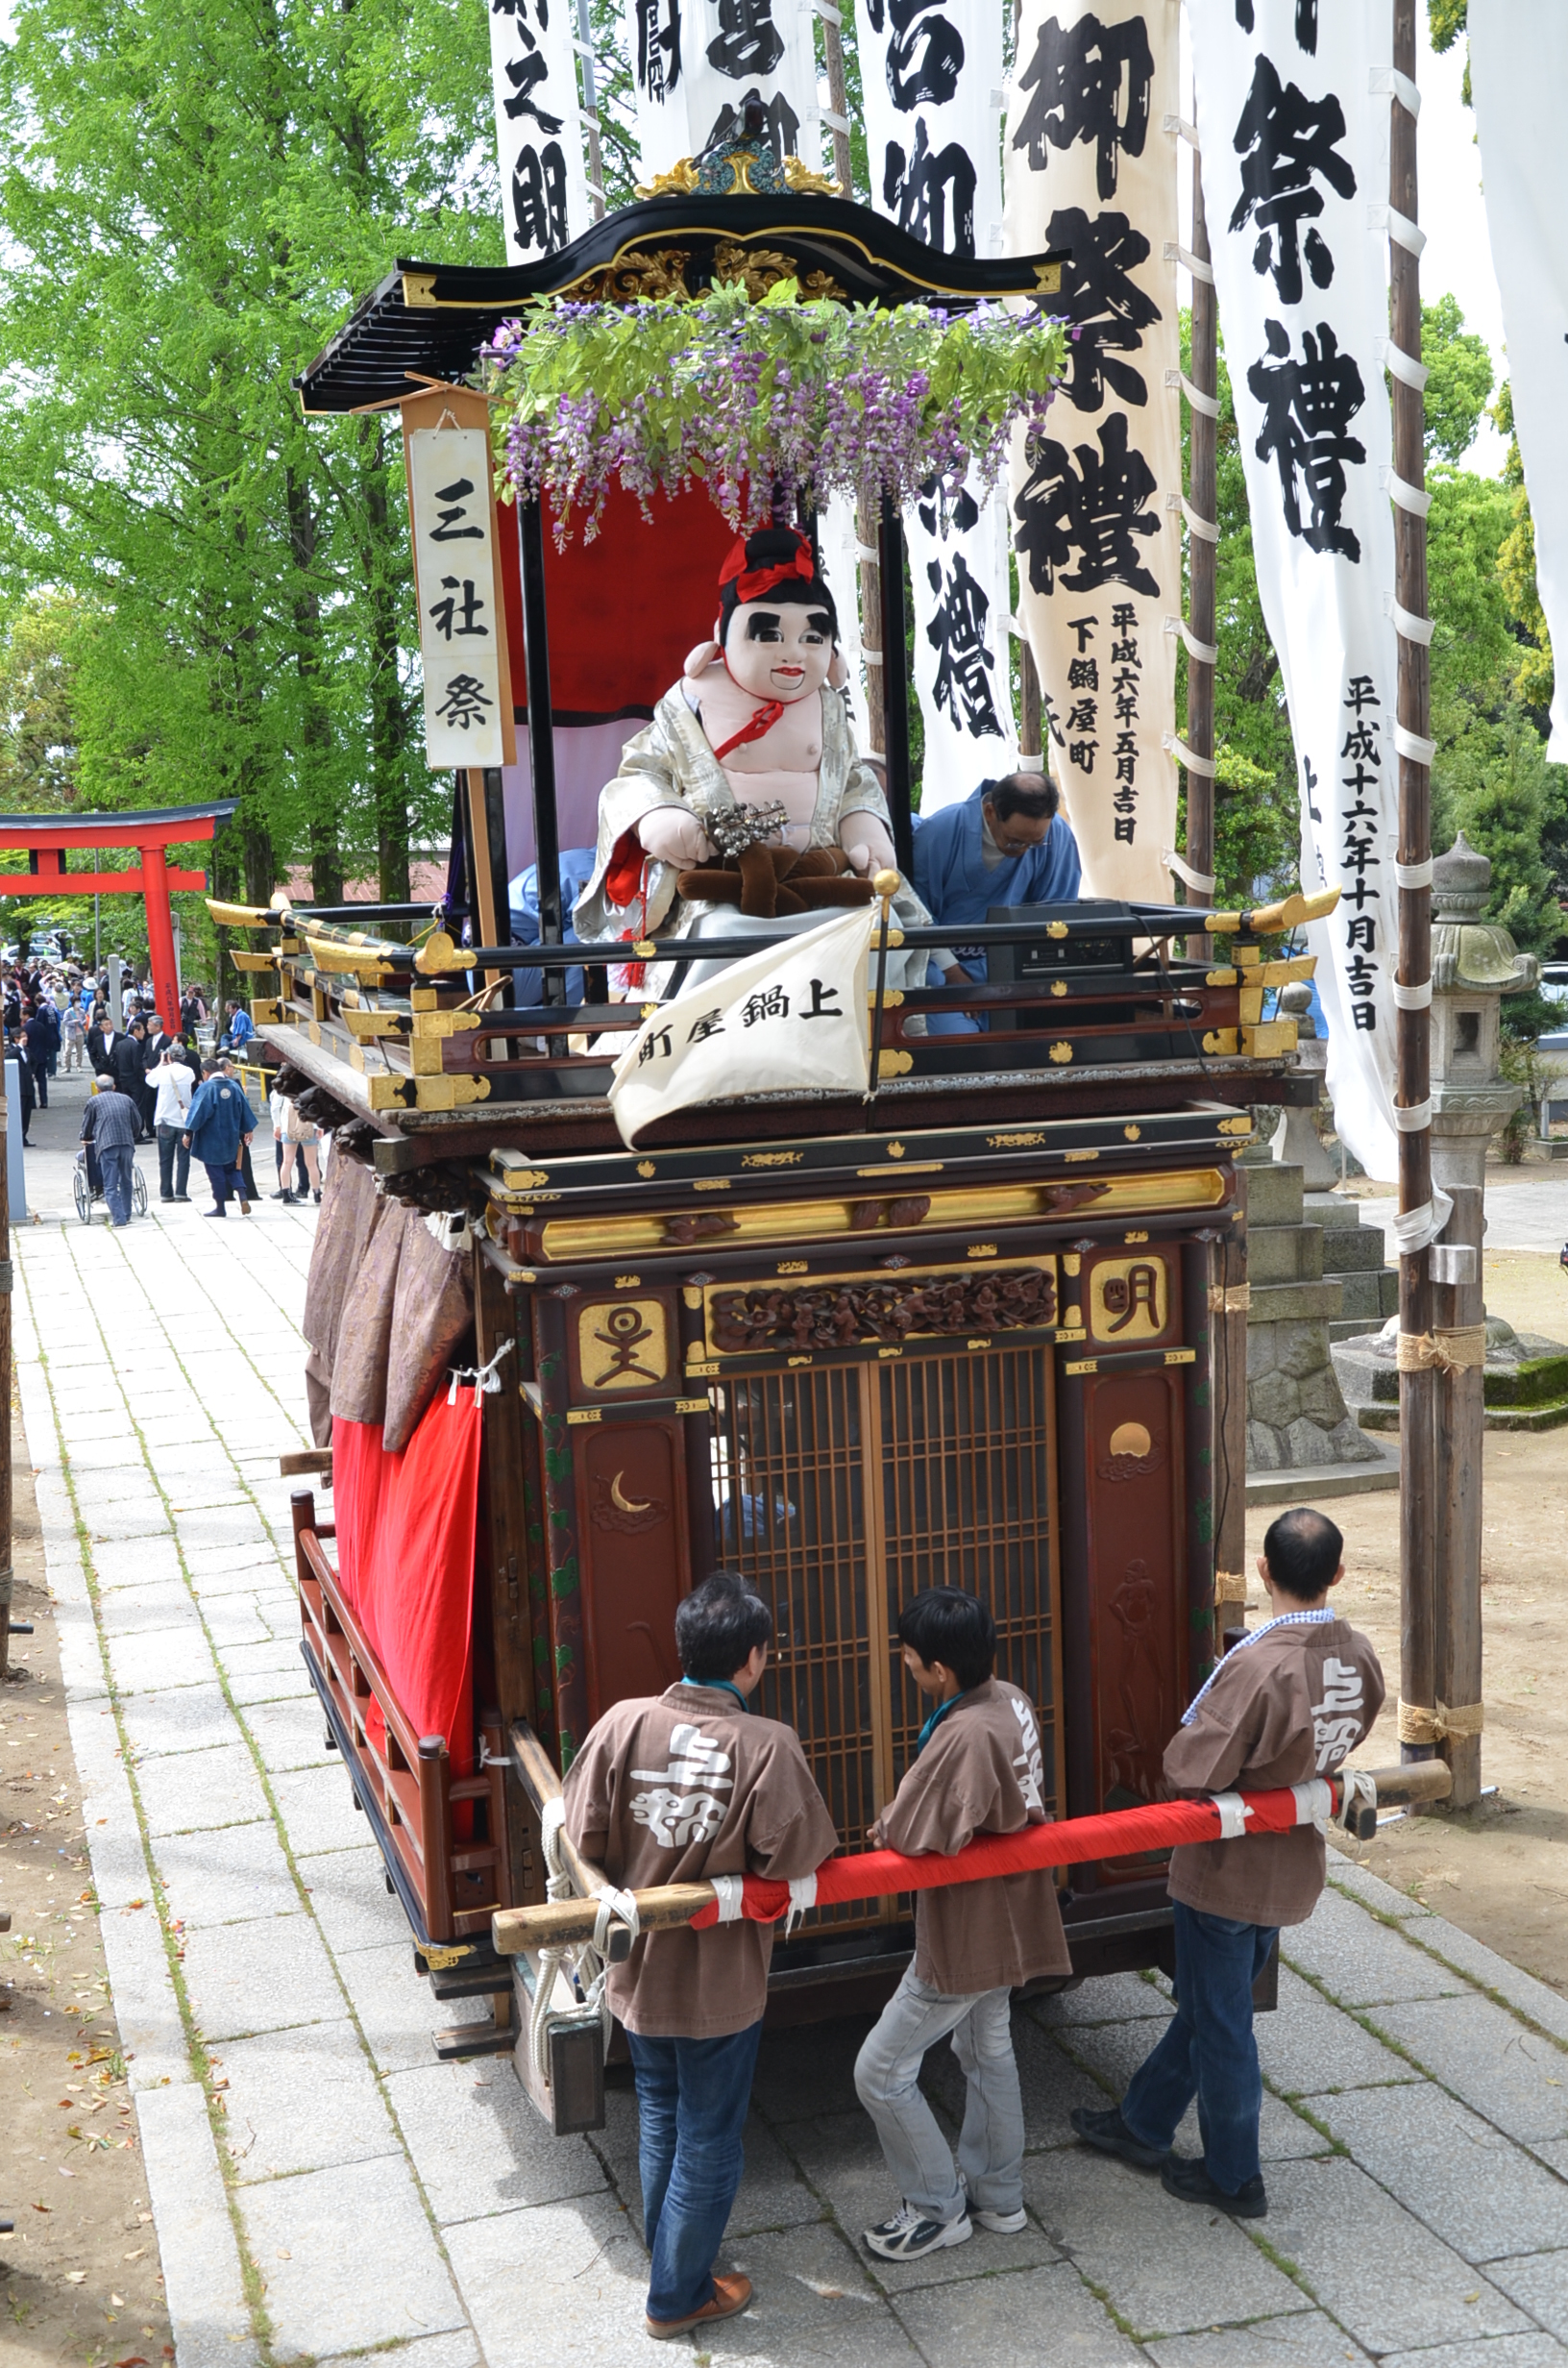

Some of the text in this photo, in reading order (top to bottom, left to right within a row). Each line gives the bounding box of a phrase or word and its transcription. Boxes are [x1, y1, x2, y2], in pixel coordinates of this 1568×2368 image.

[1229, 0, 1366, 565] 祭禮
[429, 478, 494, 730] 三社祭
[1065, 615, 1100, 775] 下鍋屋町
[1111, 603, 1143, 846] 平成六年五月吉日
[1340, 675, 1382, 1032] 平成十六年十月吉日
